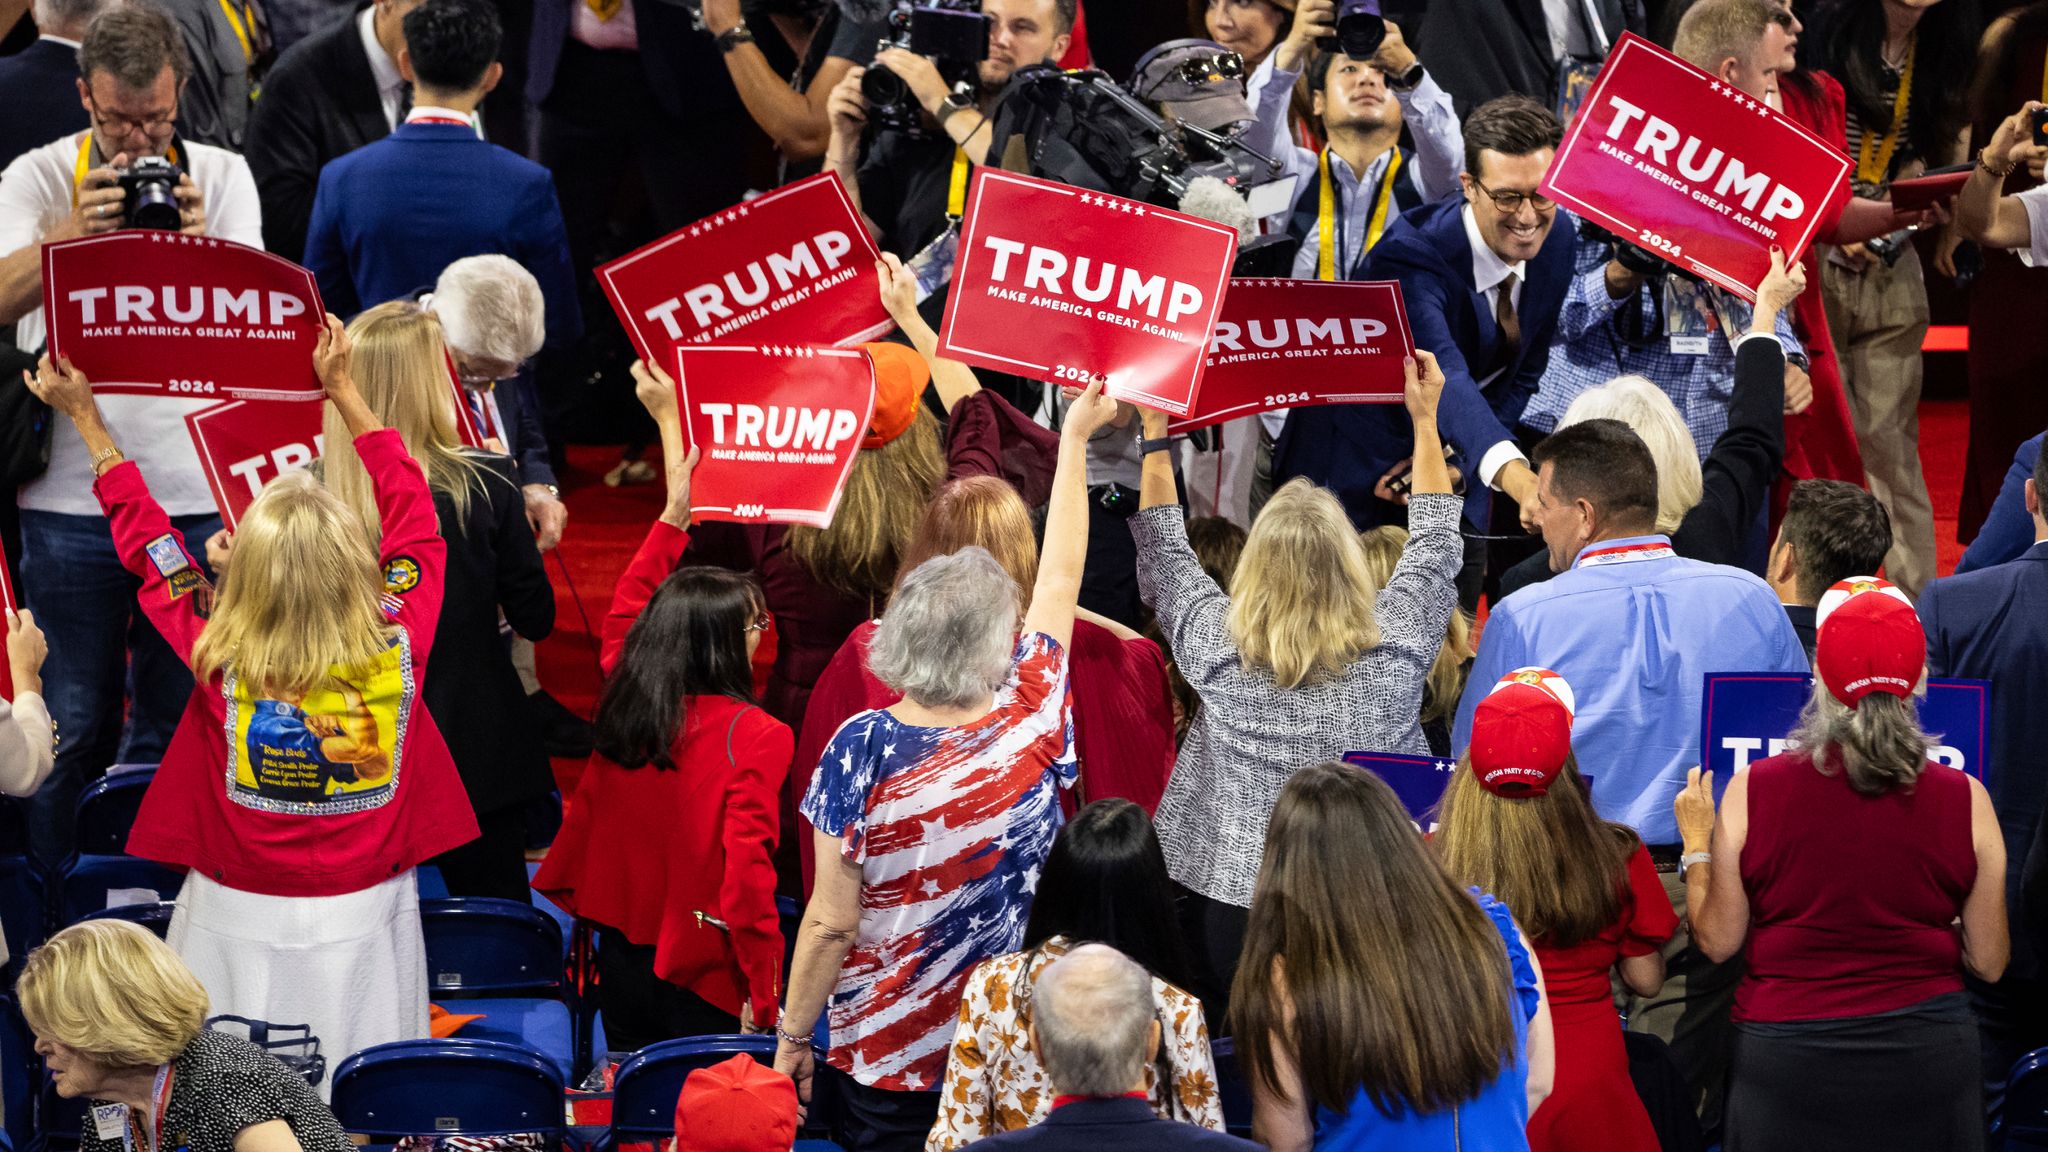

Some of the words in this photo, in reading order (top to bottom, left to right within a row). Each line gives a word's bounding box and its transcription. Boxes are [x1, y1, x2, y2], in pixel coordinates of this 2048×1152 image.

[1608, 95, 1805, 222] TRUMP
[1598, 140, 1634, 165] MAKE
[1634, 158, 1690, 195] AMERICA
[1691, 189, 1733, 216] GREAT
[1732, 212, 1778, 240] AGAIN!
[1639, 228, 1682, 257] 2024
[645, 230, 851, 340] TRUMP
[984, 235, 1204, 324] TRUMP
[68, 285, 306, 326] TRUMP
[687, 331, 713, 343] KE
[714, 308, 770, 338] AMERICA
[771, 286, 812, 312] GREAT
[814, 267, 858, 293] AGAIN!
[987, 285, 1027, 304] MAKE
[1030, 295, 1093, 318] AMERICA
[1097, 310, 1140, 329] GREAT
[1142, 325, 1185, 342] AGAIN!
[82, 326, 122, 338] MAKE
[127, 326, 192, 337] AMERICA
[196, 327, 242, 339] GREAT
[246, 329, 296, 341] AGAIN!
[1208, 318, 1388, 354] RUMP
[1054, 364, 1102, 384] 202
[1219, 352, 1281, 365] AMERICA
[1285, 348, 1329, 358] GREAT
[1333, 347, 1381, 356] AGAIN!
[168, 379, 215, 393] 2024
[1264, 391, 1310, 406] 2024
[699, 402, 858, 451] TRUMP
[712, 449, 737, 461] MAKE
[737, 450, 775, 463] AMERICA
[777, 452, 806, 464] GREAT
[733, 504, 765, 517] 2024
